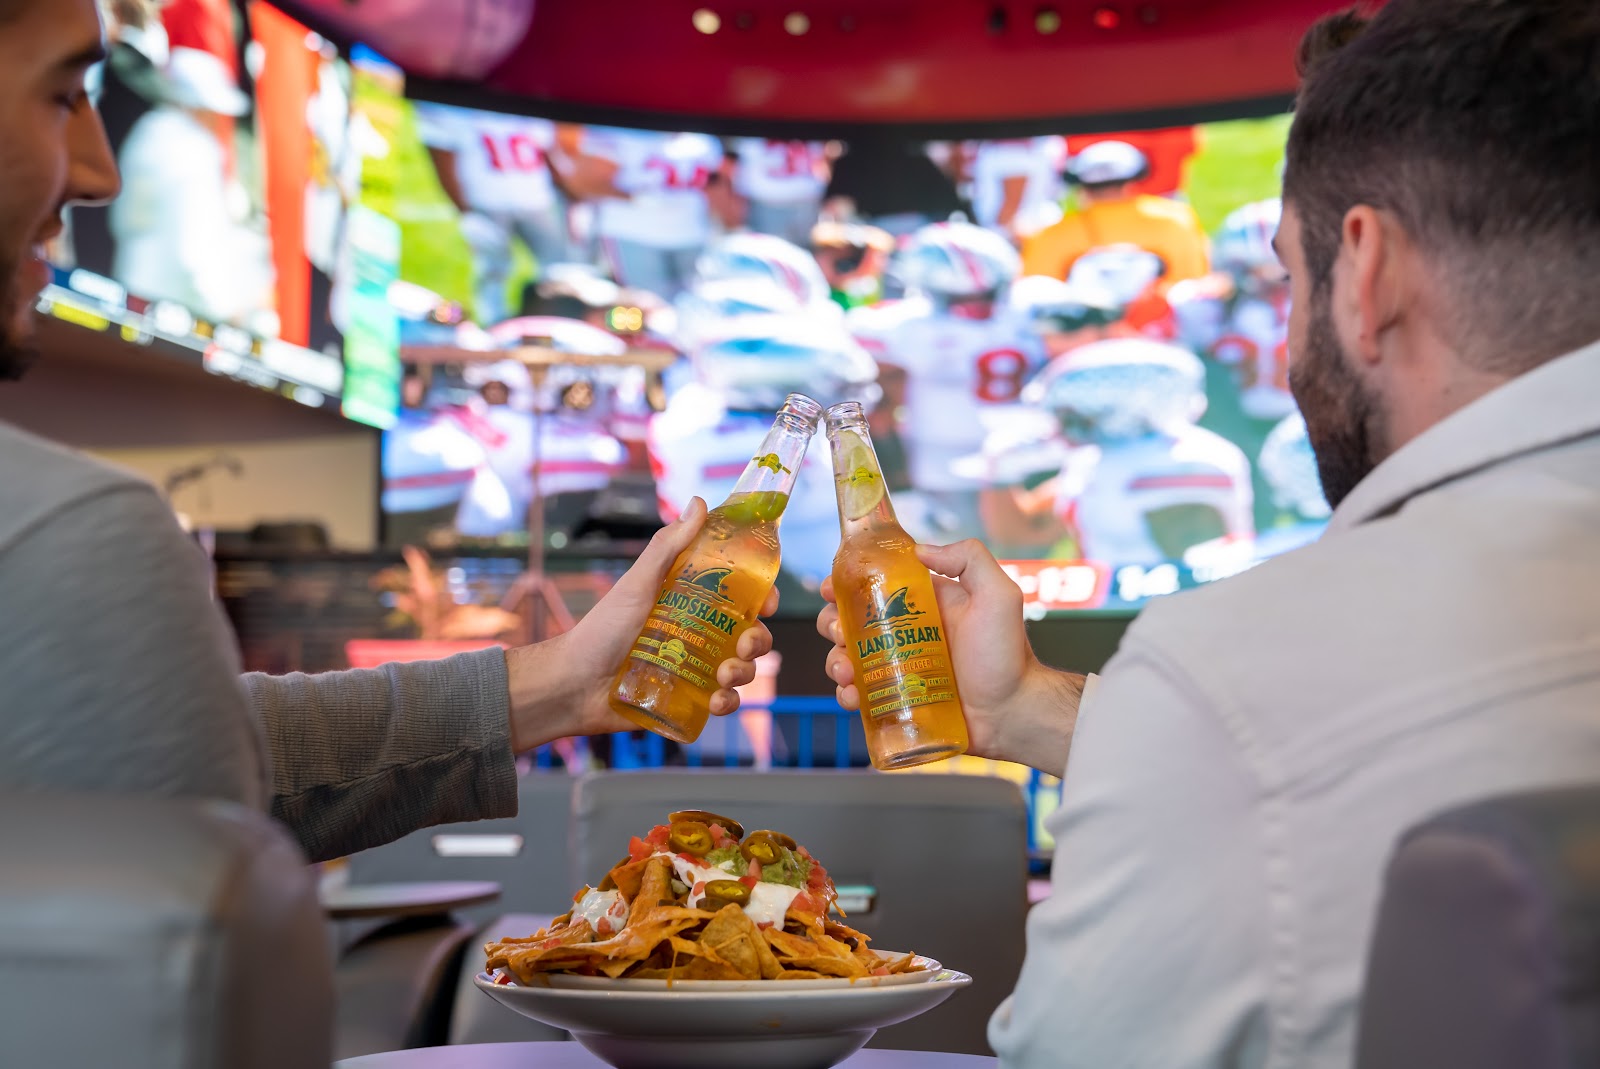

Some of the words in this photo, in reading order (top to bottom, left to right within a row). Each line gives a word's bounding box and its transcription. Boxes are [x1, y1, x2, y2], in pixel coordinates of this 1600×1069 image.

[657, 589, 737, 635] LANDSHARK
[668, 608, 708, 631] Lager
[682, 630, 706, 648] LAGER
[857, 627, 941, 659] LANDSHARK
[884, 647, 924, 662] Lager
[908, 659, 932, 670] LAGER
